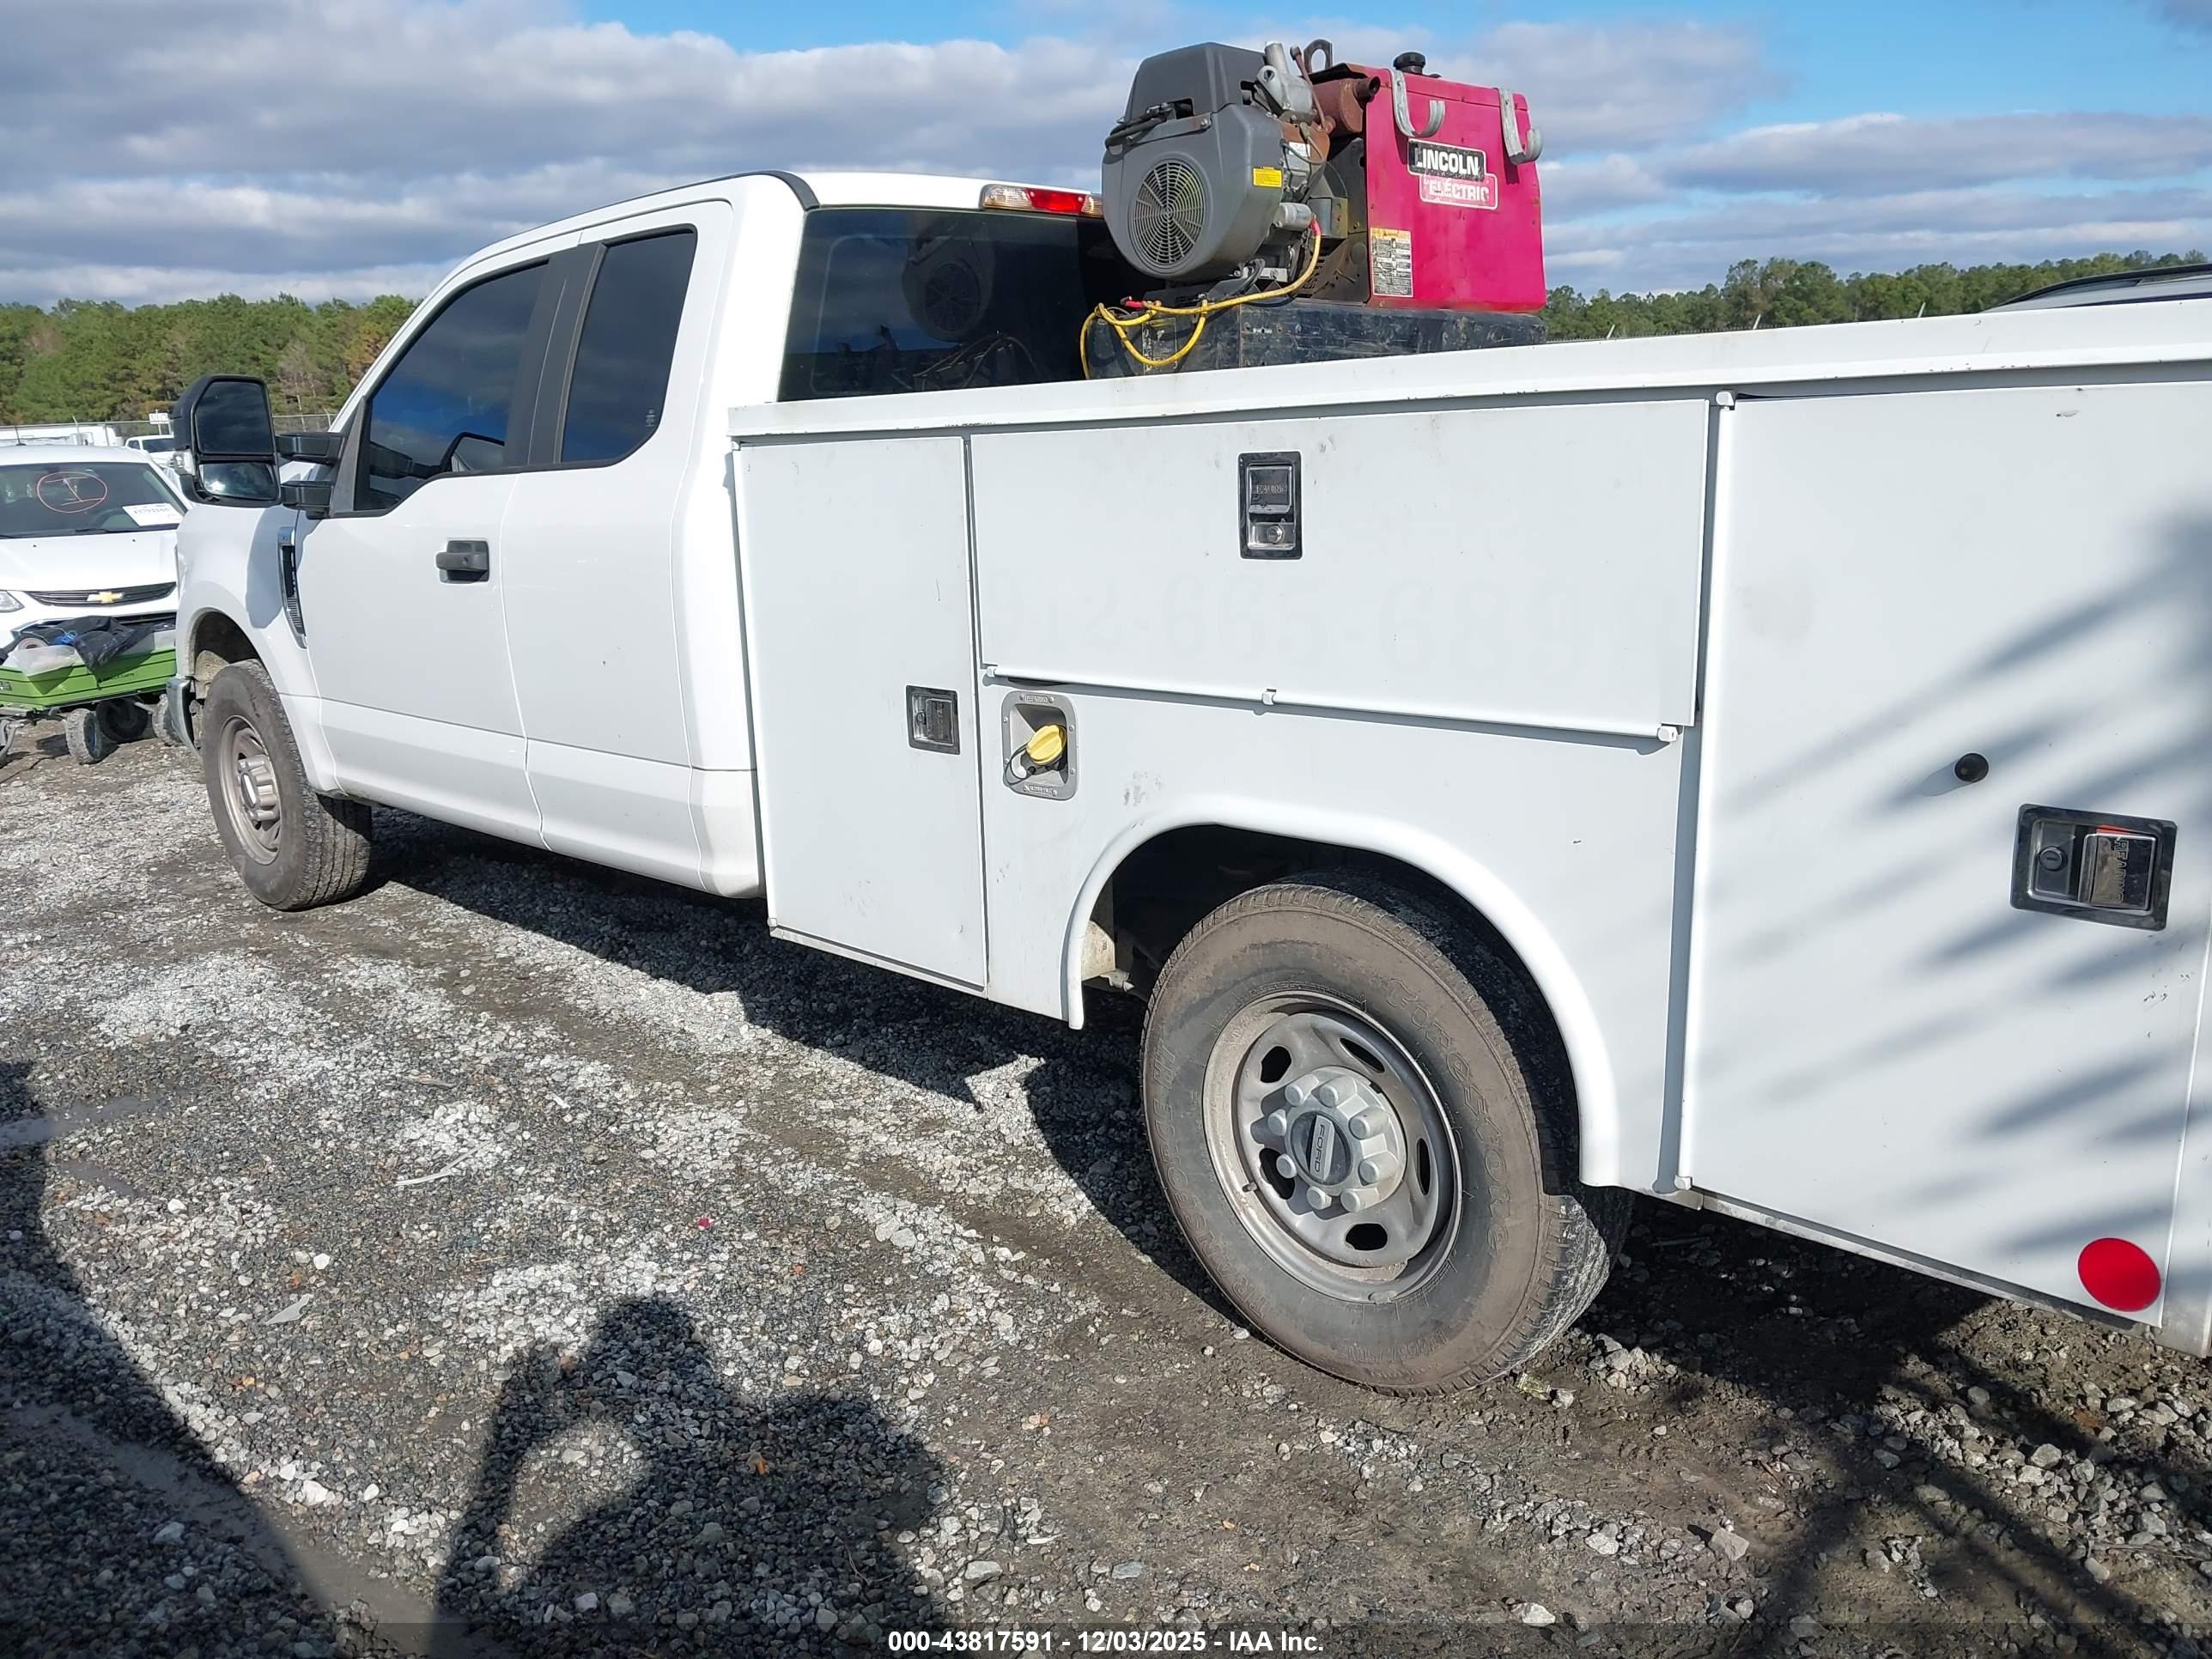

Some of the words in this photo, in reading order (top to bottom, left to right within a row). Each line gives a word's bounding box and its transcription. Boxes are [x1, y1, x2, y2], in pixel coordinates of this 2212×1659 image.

[1414, 147, 1480, 177] LINCOLN
[1428, 179, 1491, 203] ELECTRIC
[1314, 1123, 1326, 1173] FORD
